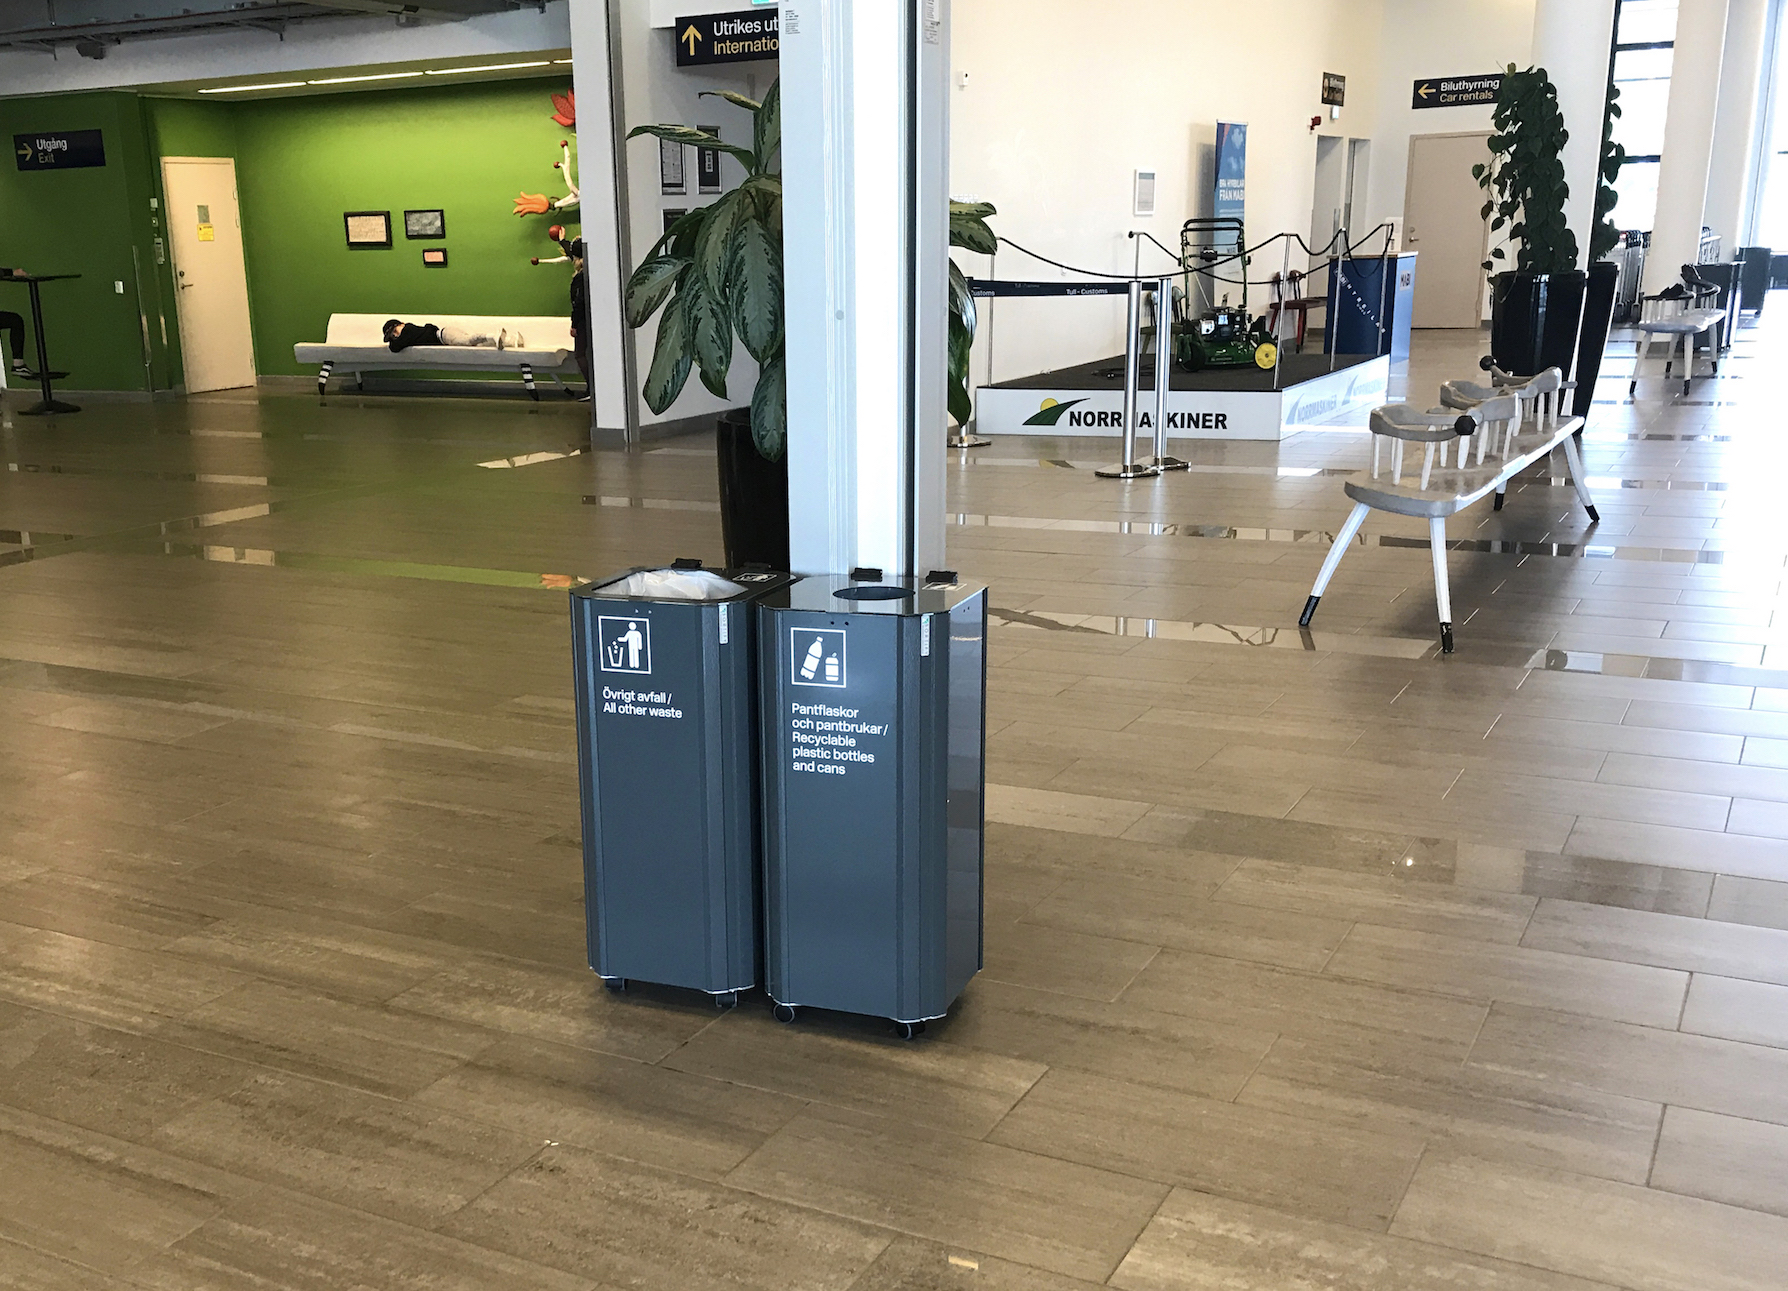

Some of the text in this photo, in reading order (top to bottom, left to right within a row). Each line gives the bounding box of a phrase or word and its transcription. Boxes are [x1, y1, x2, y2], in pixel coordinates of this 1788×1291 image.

[713, 19, 761, 36] Utrikes
[713, 36, 778, 55] Internatio
[1440, 79, 1500, 92] Biluthyrning
[1440, 90, 1493, 103] Car rentals
[36, 137, 68, 152] Utgång
[38, 152, 55, 163] Exit
[1069, 411, 1228, 430] NORRAKINER
[602, 686, 636, 703] Övrigt
[603, 702, 683, 719] All other waste
[792, 702, 860, 719] Pantflaskor
[792, 718, 814, 730] och
[792, 731, 857, 748] Recyclable
[792, 745, 876, 764] plastic bottles
[792, 761, 847, 776] and cans
